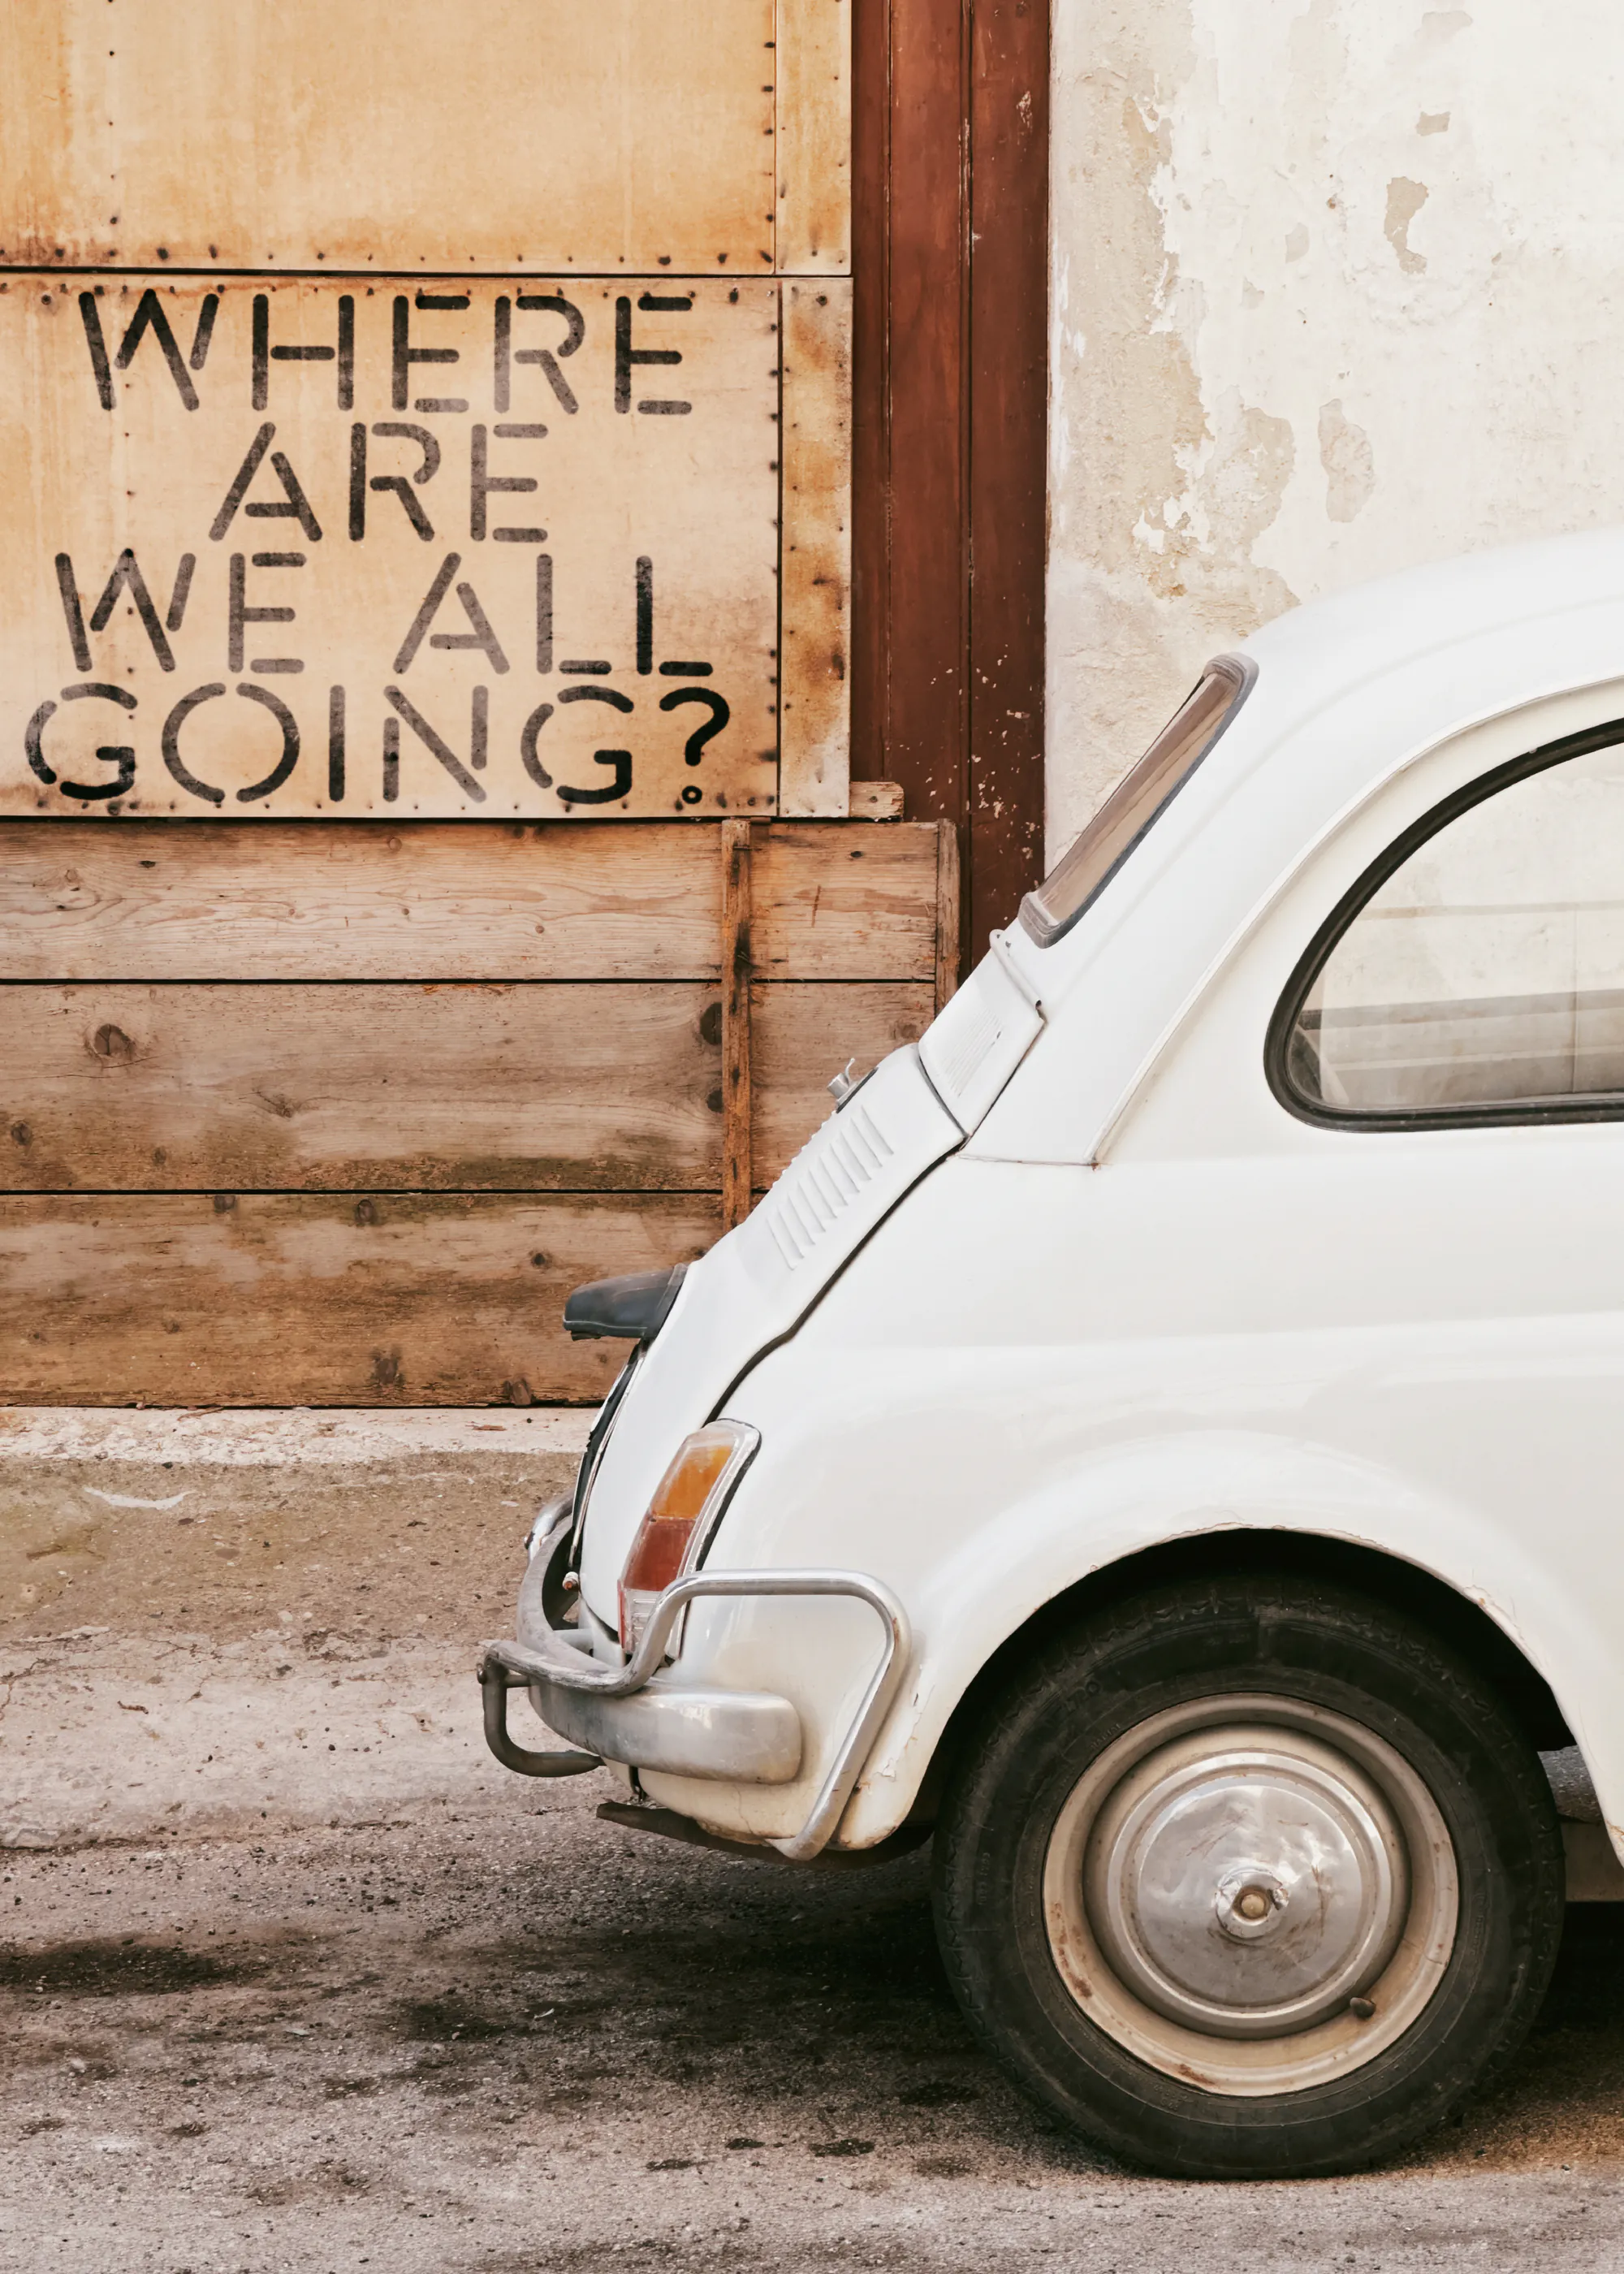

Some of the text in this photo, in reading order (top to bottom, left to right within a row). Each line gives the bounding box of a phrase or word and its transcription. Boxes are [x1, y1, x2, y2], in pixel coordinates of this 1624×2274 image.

[79, 289, 692, 414] WHERE
[209, 422, 548, 541] ARE
[54, 549, 713, 676] WE ALL
[24, 682, 730, 804] GOING?
